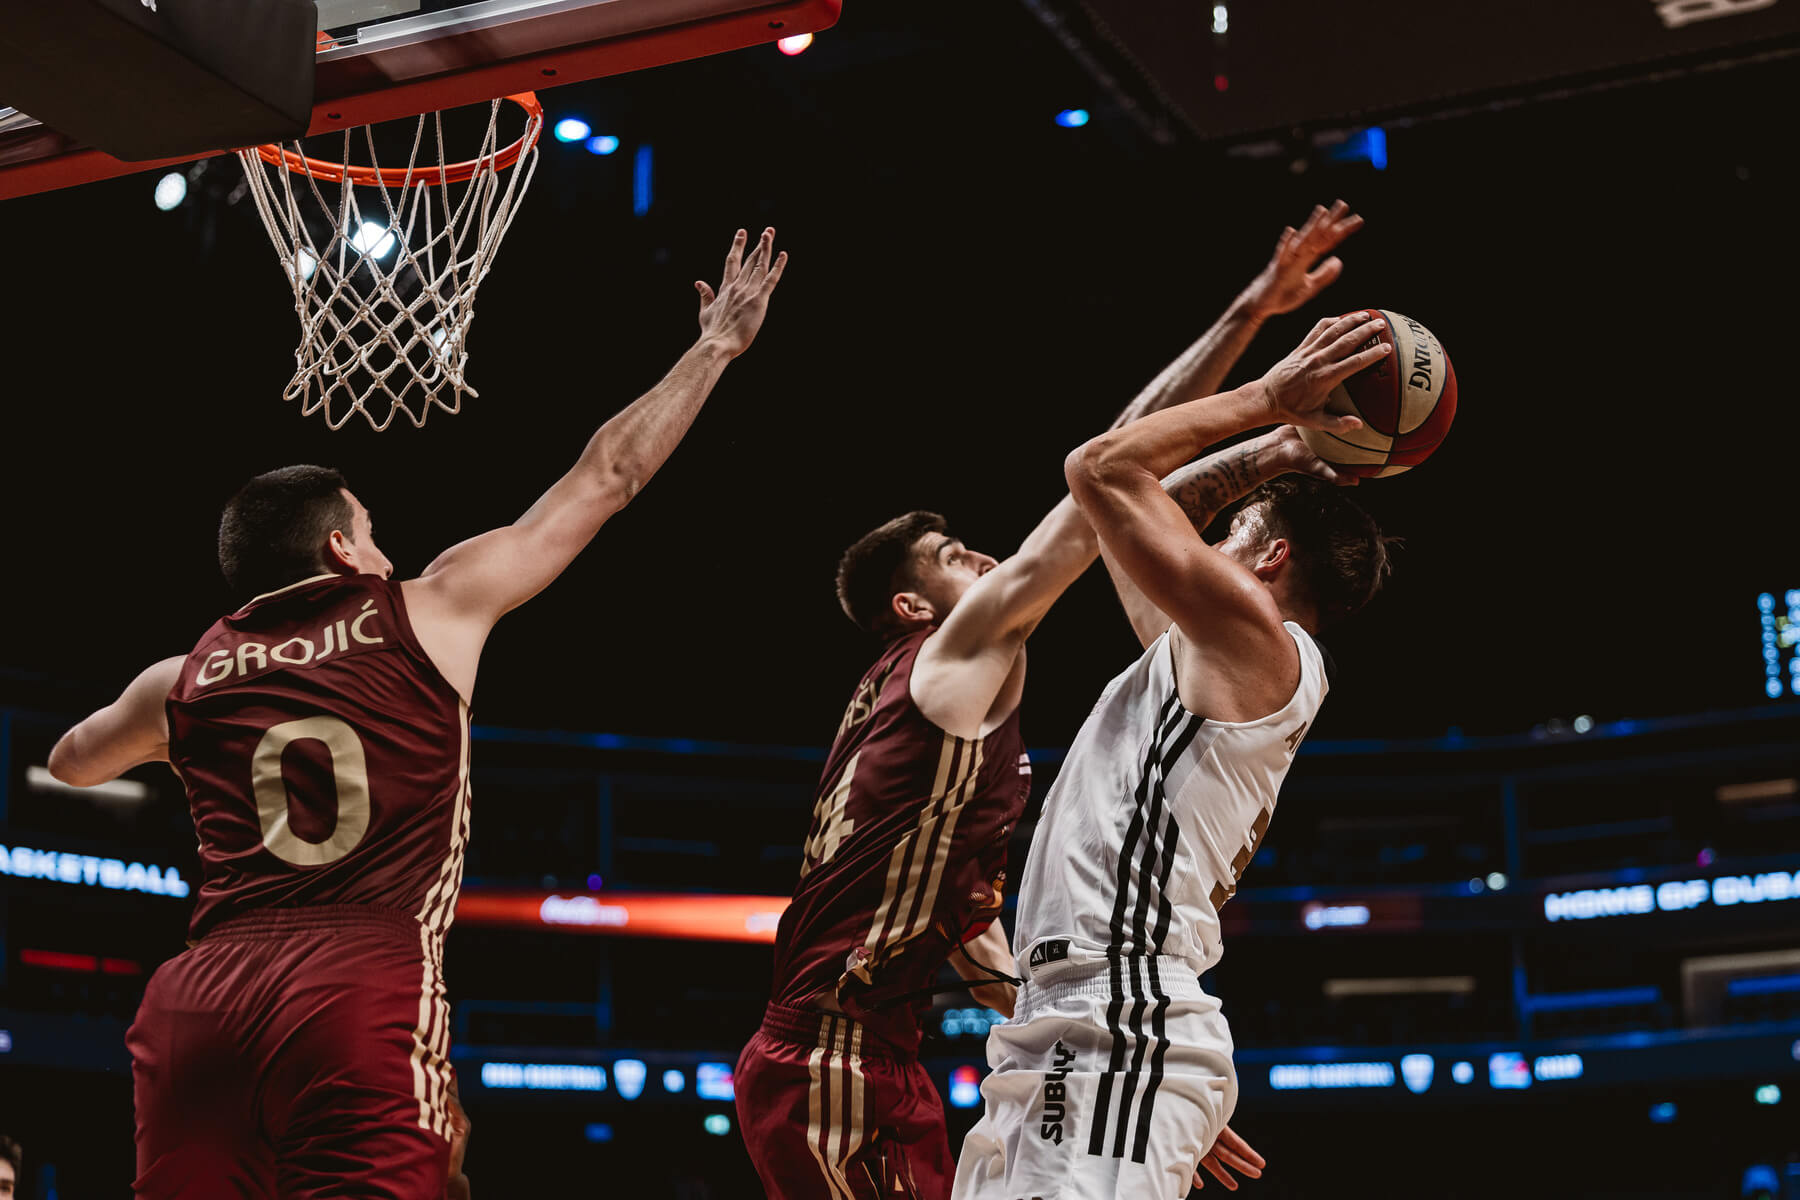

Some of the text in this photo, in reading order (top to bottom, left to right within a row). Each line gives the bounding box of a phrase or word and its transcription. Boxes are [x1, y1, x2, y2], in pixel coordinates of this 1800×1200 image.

[196, 599, 384, 686] GROJIĆ
[252, 715, 371, 867] 0
[1544, 884, 1655, 922] HOME
[1657, 879, 1710, 911] OF
